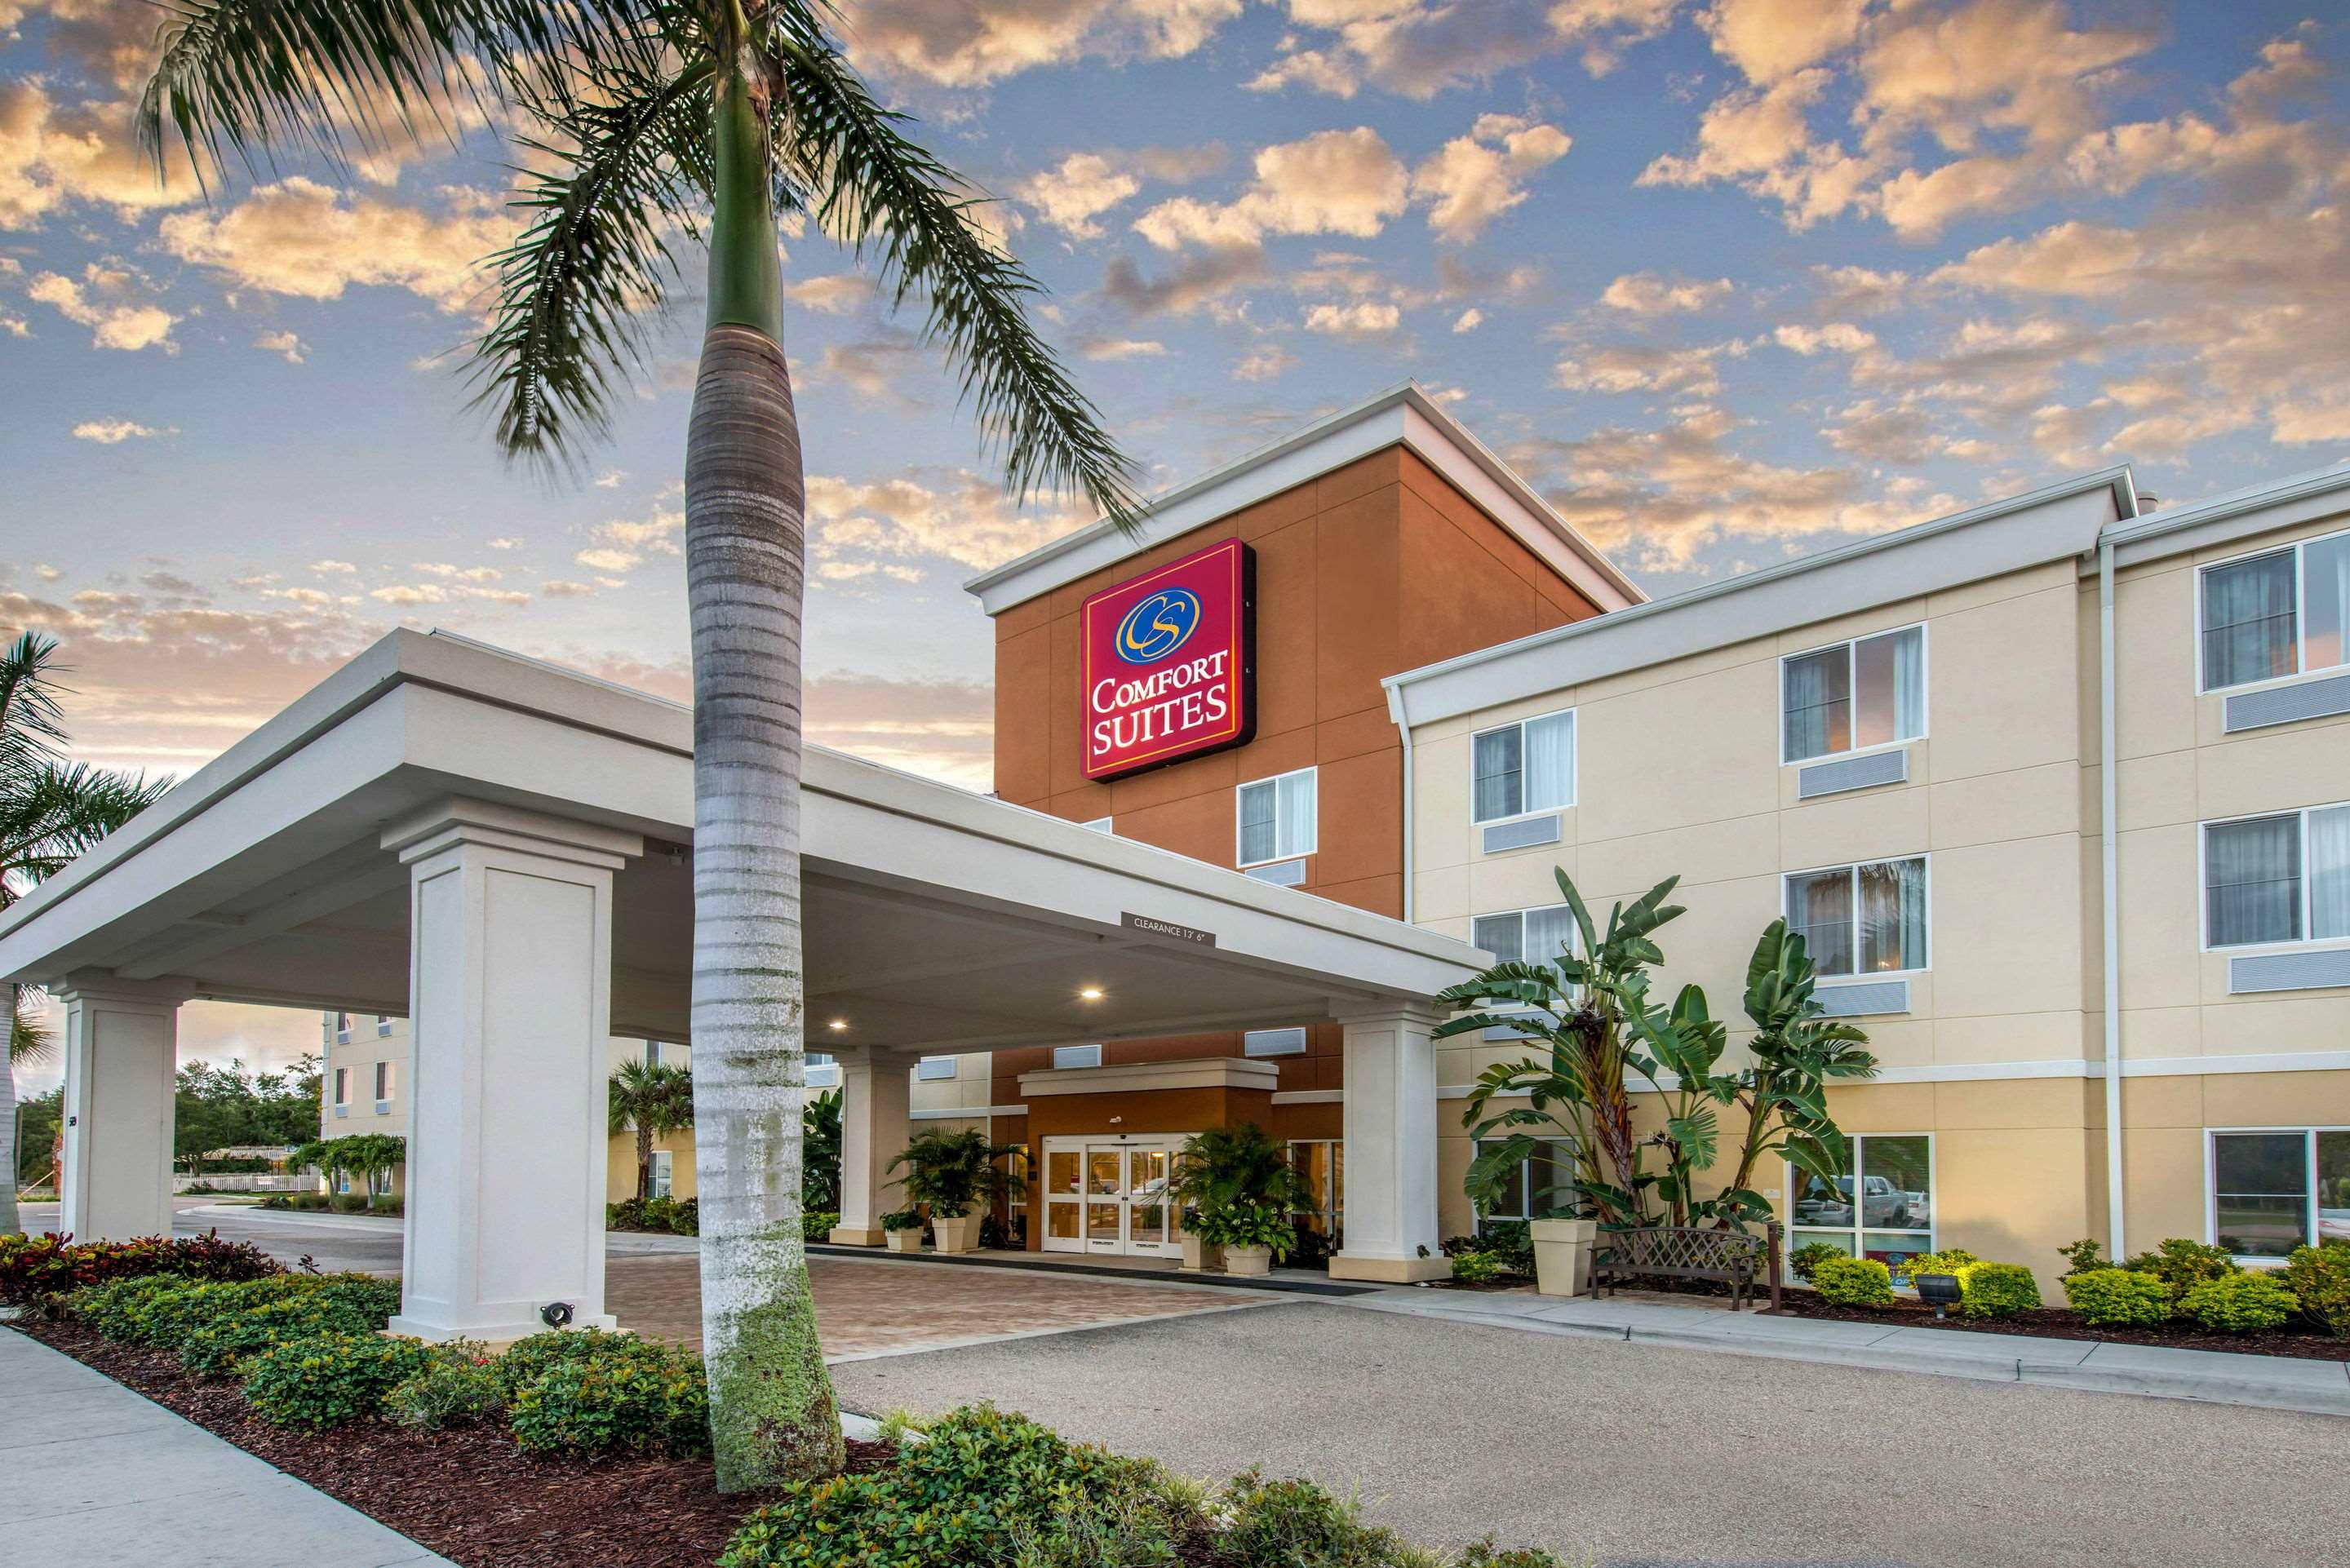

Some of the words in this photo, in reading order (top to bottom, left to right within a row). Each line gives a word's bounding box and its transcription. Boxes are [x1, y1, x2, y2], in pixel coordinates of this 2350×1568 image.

[1093, 649, 1228, 713] COMFORT
[1093, 684, 1227, 755] SUITES
[1134, 918, 1181, 937] CLEARANCE
